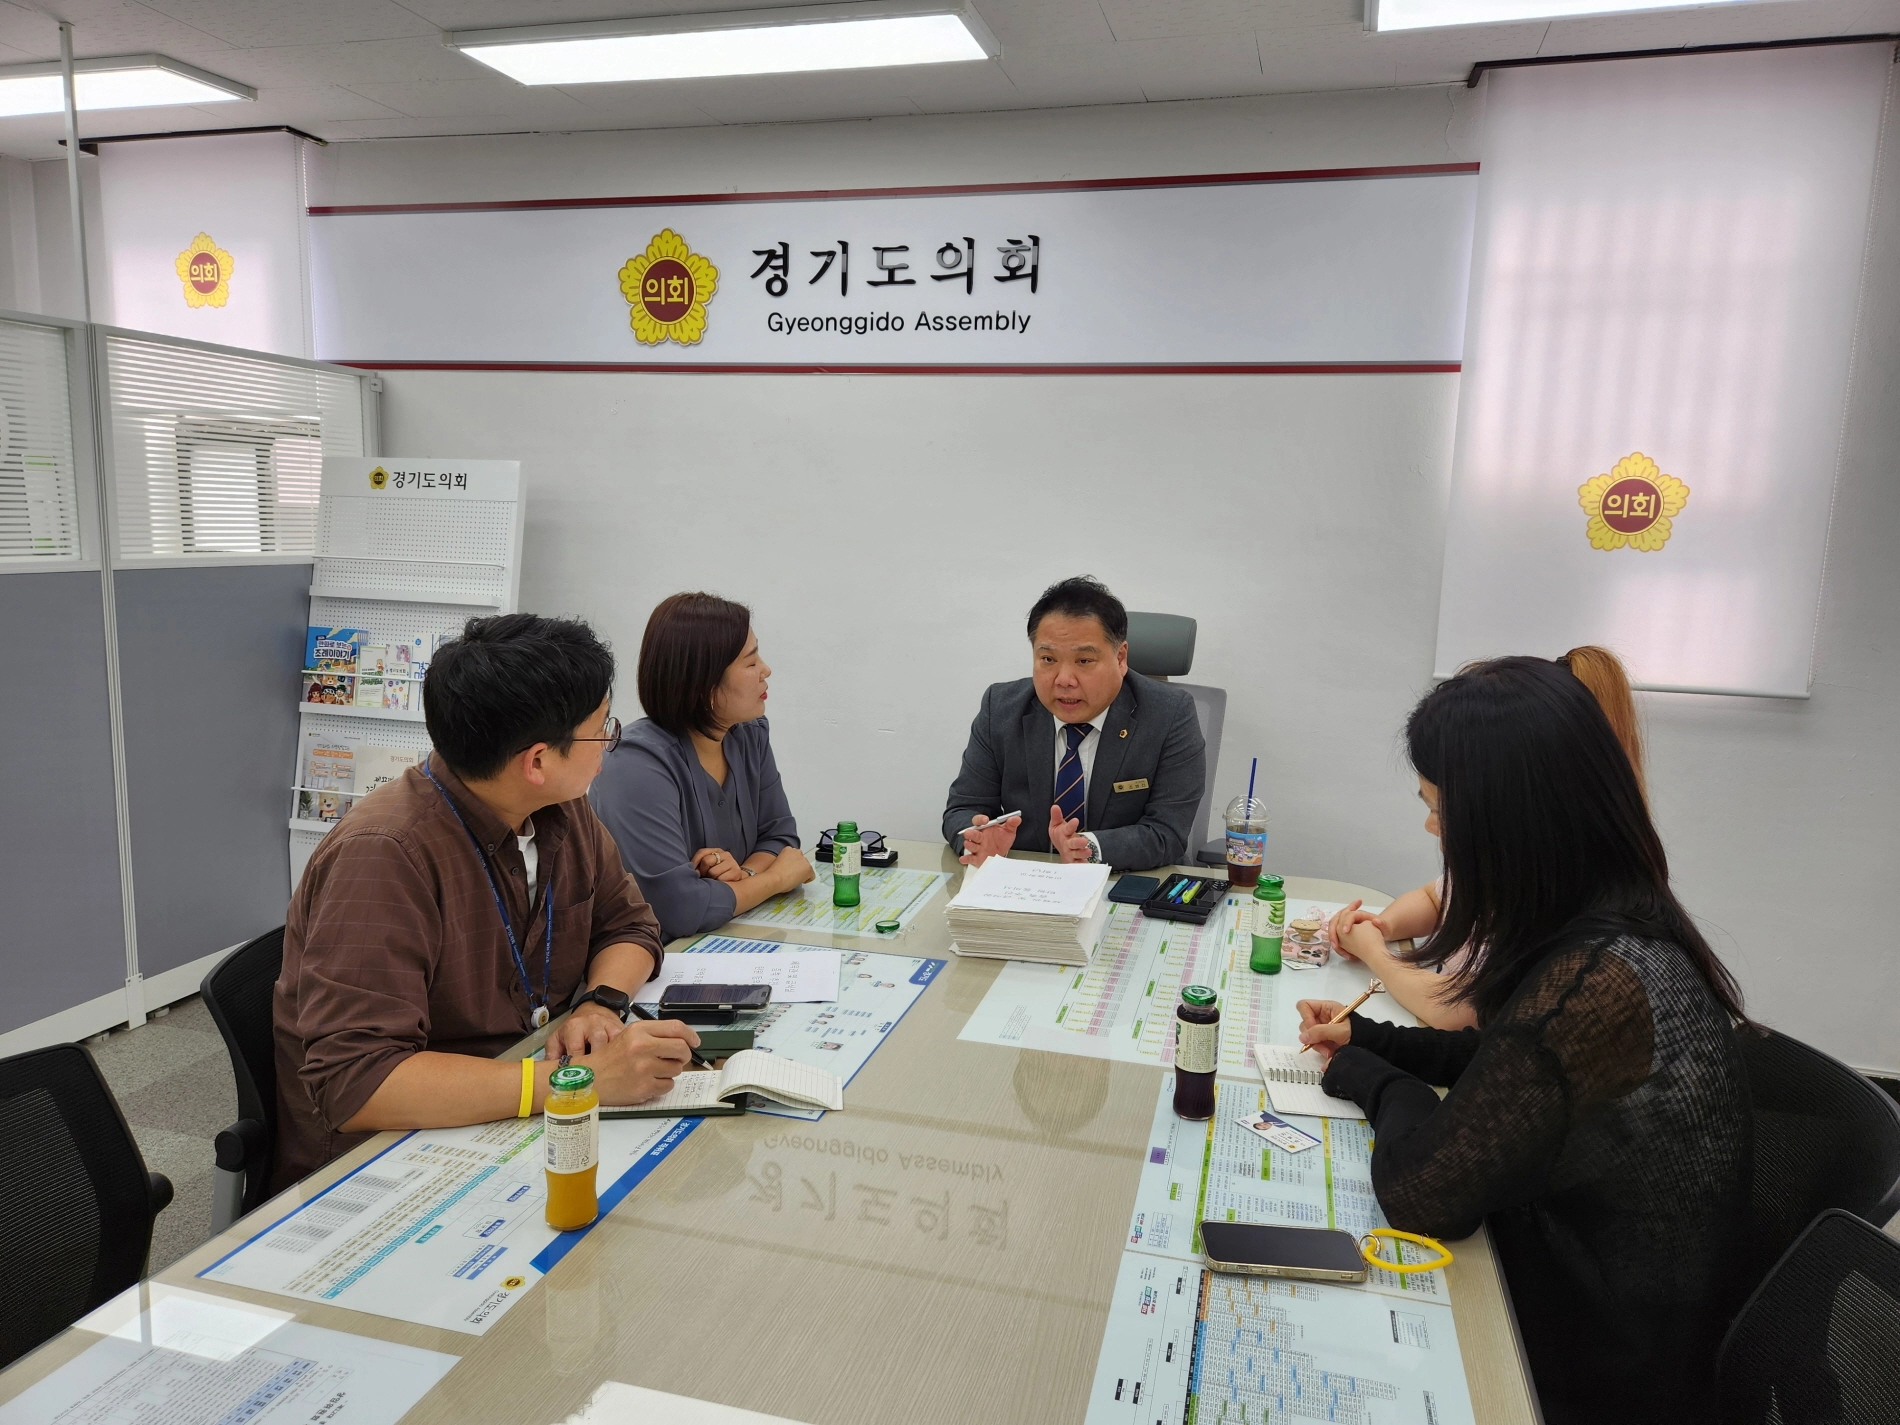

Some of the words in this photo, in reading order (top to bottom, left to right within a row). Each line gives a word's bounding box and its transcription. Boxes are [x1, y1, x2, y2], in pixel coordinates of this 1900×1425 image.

[190, 263, 219, 284] 의회
[751, 235, 1040, 297] 경기도의회
[643, 275, 690, 306] 의회
[767, 312, 905, 335] Gyeonggido
[914, 311, 1032, 334] Assembly
[392, 471, 468, 491] 경기도의회
[1604, 492, 1656, 518] 의회
[470, 1291, 510, 1324] 경기도의회
